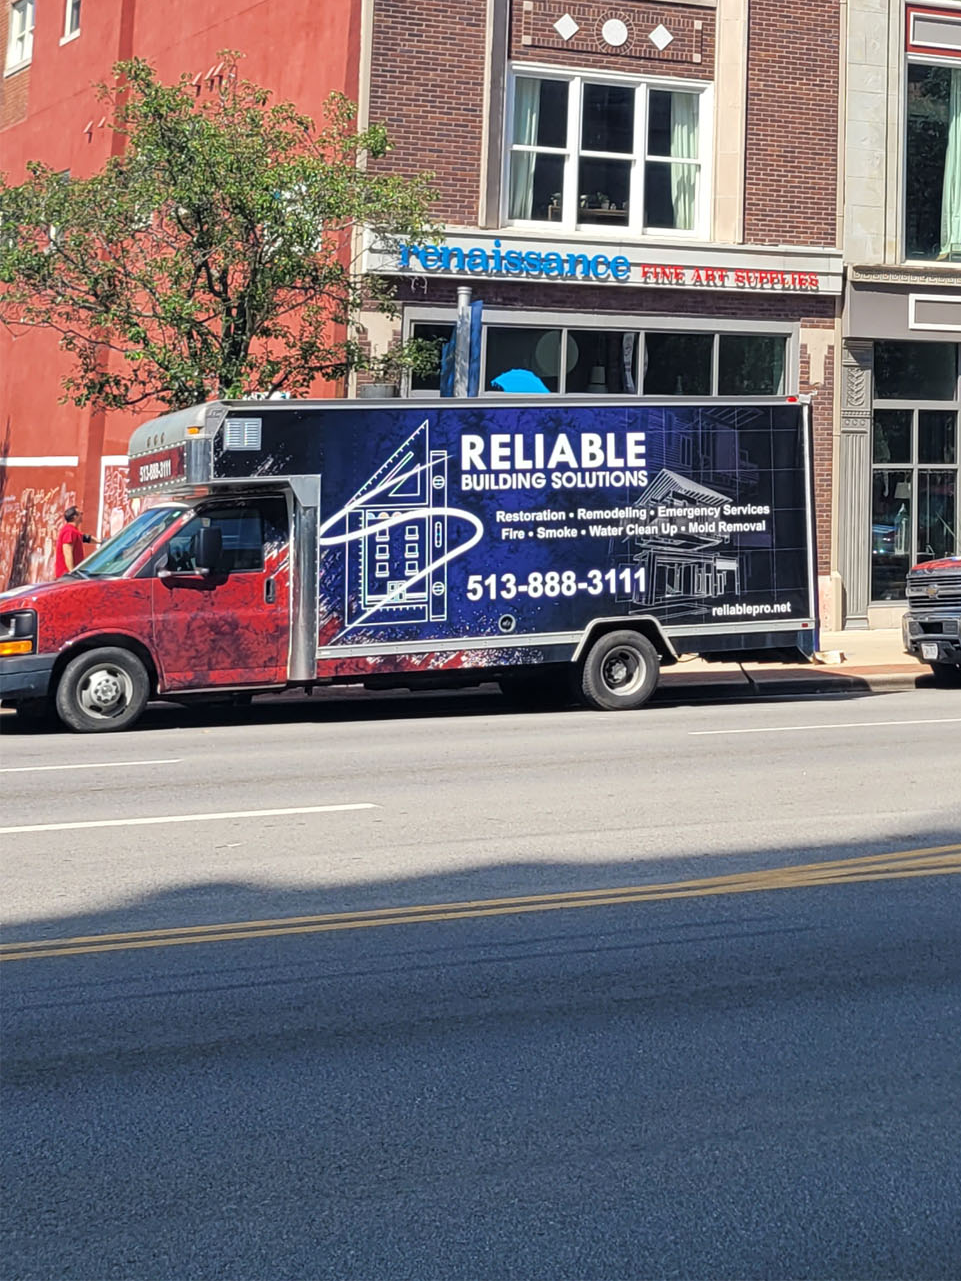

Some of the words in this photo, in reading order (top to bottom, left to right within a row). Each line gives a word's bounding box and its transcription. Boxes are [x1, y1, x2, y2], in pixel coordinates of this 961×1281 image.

[398, 239, 631, 278] renaissance
[641, 264, 684, 282] FINE
[691, 267, 725, 284] ART
[734, 269, 820, 288] SUPPLIES
[461, 432, 647, 471] RELIABLE
[139, 459, 172, 483] 513-888-3111
[461, 472, 547, 491] BUILDING
[551, 470, 649, 489] SOLUTIONS
[496, 509, 566, 523] Restoration
[577, 507, 647, 520] Remodeling
[657, 505, 721, 519] Emergency
[723, 503, 770, 516] Services
[501, 527, 525, 540] Fire
[536, 526, 578, 539] Smoke
[589, 524, 624, 537] Water
[626, 523, 659, 535] Clean
[661, 522, 678, 536] Up
[688, 521, 716, 534] Mold
[718, 520, 766, 532] Removal
[465, 567, 646, 601] 513-888-3111
[711, 601, 791, 617] reliablepro.net
